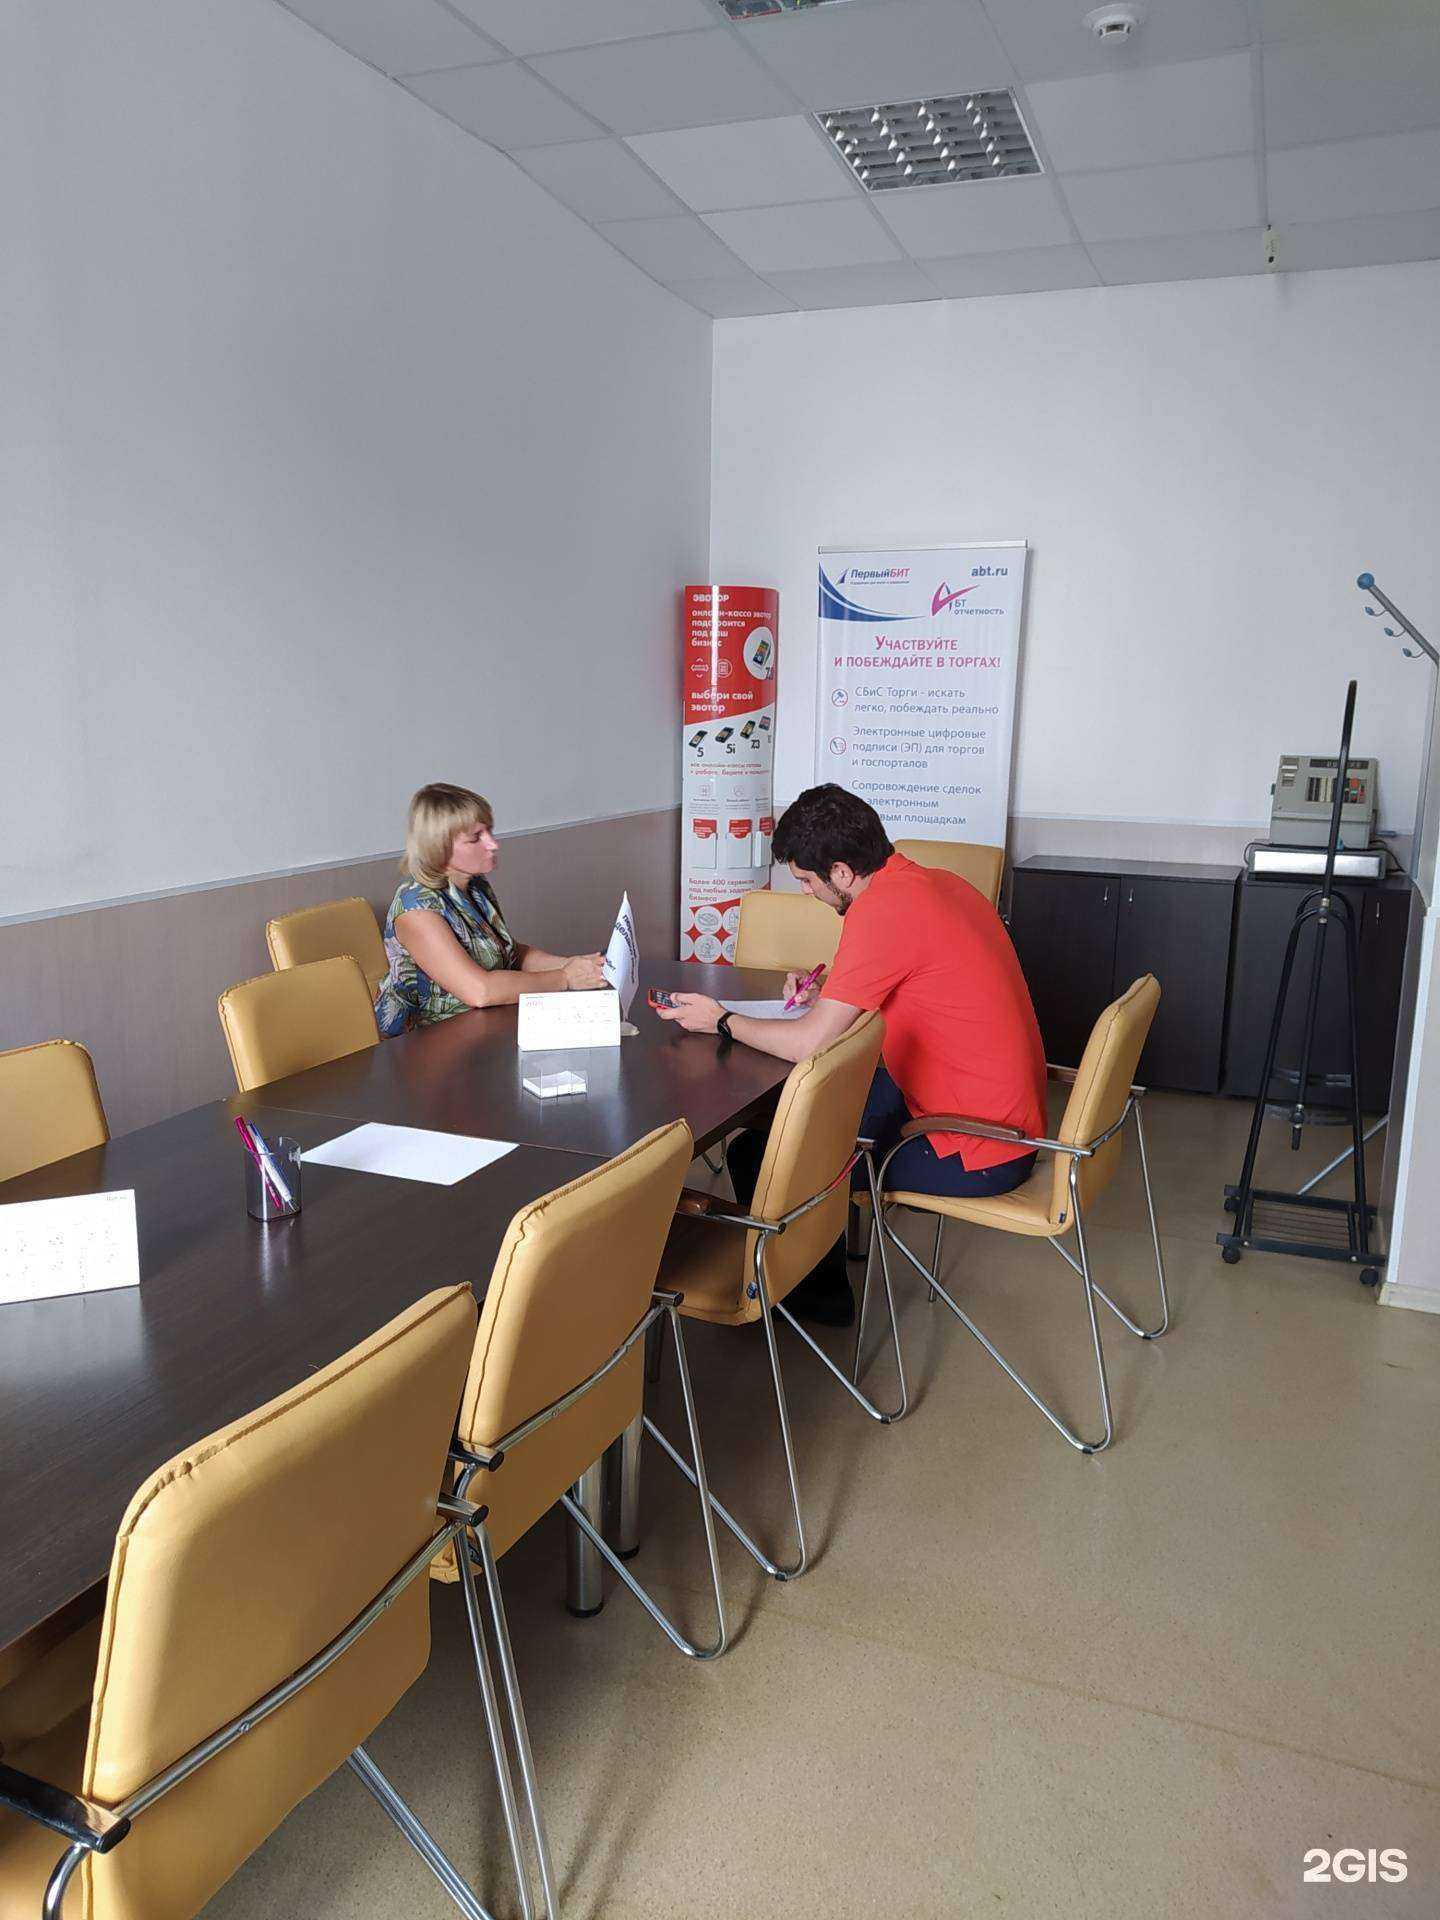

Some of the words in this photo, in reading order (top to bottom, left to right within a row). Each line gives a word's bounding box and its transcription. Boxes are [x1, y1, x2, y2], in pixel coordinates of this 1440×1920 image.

[971, 565, 1008, 577] abt.ru
[692, 593, 730, 602] ЭВООР
[954, 608, 1005, 616] отчетность
[691, 619, 746, 629] подсроится
[691, 630, 709, 638] под
[691, 637, 723, 647] бизнс
[834, 656, 843, 668] И
[846, 654, 933, 669] ПОБЕЖДАЙТЕ
[936, 656, 945, 668] В
[949, 655, 1001, 668] ТОРГАХ!
[732, 691, 754, 700] свой
[855, 686, 883, 698] СБиС
[887, 687, 918, 700] Торги
[927, 689, 966, 698] искать
[690, 704, 726, 714] эвотор
[854, 703, 887, 714] легко,
[889, 703, 949, 714] побеждать
[951, 705, 999, 716] реально
[852, 726, 926, 740] Электронные
[928, 726, 987, 741] цифровые
[697, 747, 704, 758] 5
[852, 743, 898, 754] подписи
[900, 742, 923, 754] (ЭП)
[925, 744, 945, 755] для
[947, 745, 985, 756] торгов
[851, 758, 859, 767] и
[861, 759, 929, 769] госпорталов
[851, 779, 940, 795] Сопровождение
[942, 784, 982, 796] сделок
[867, 797, 940, 810] электронным
[904, 813, 967, 826] площадкам
[711, 879, 726, 887] 400
